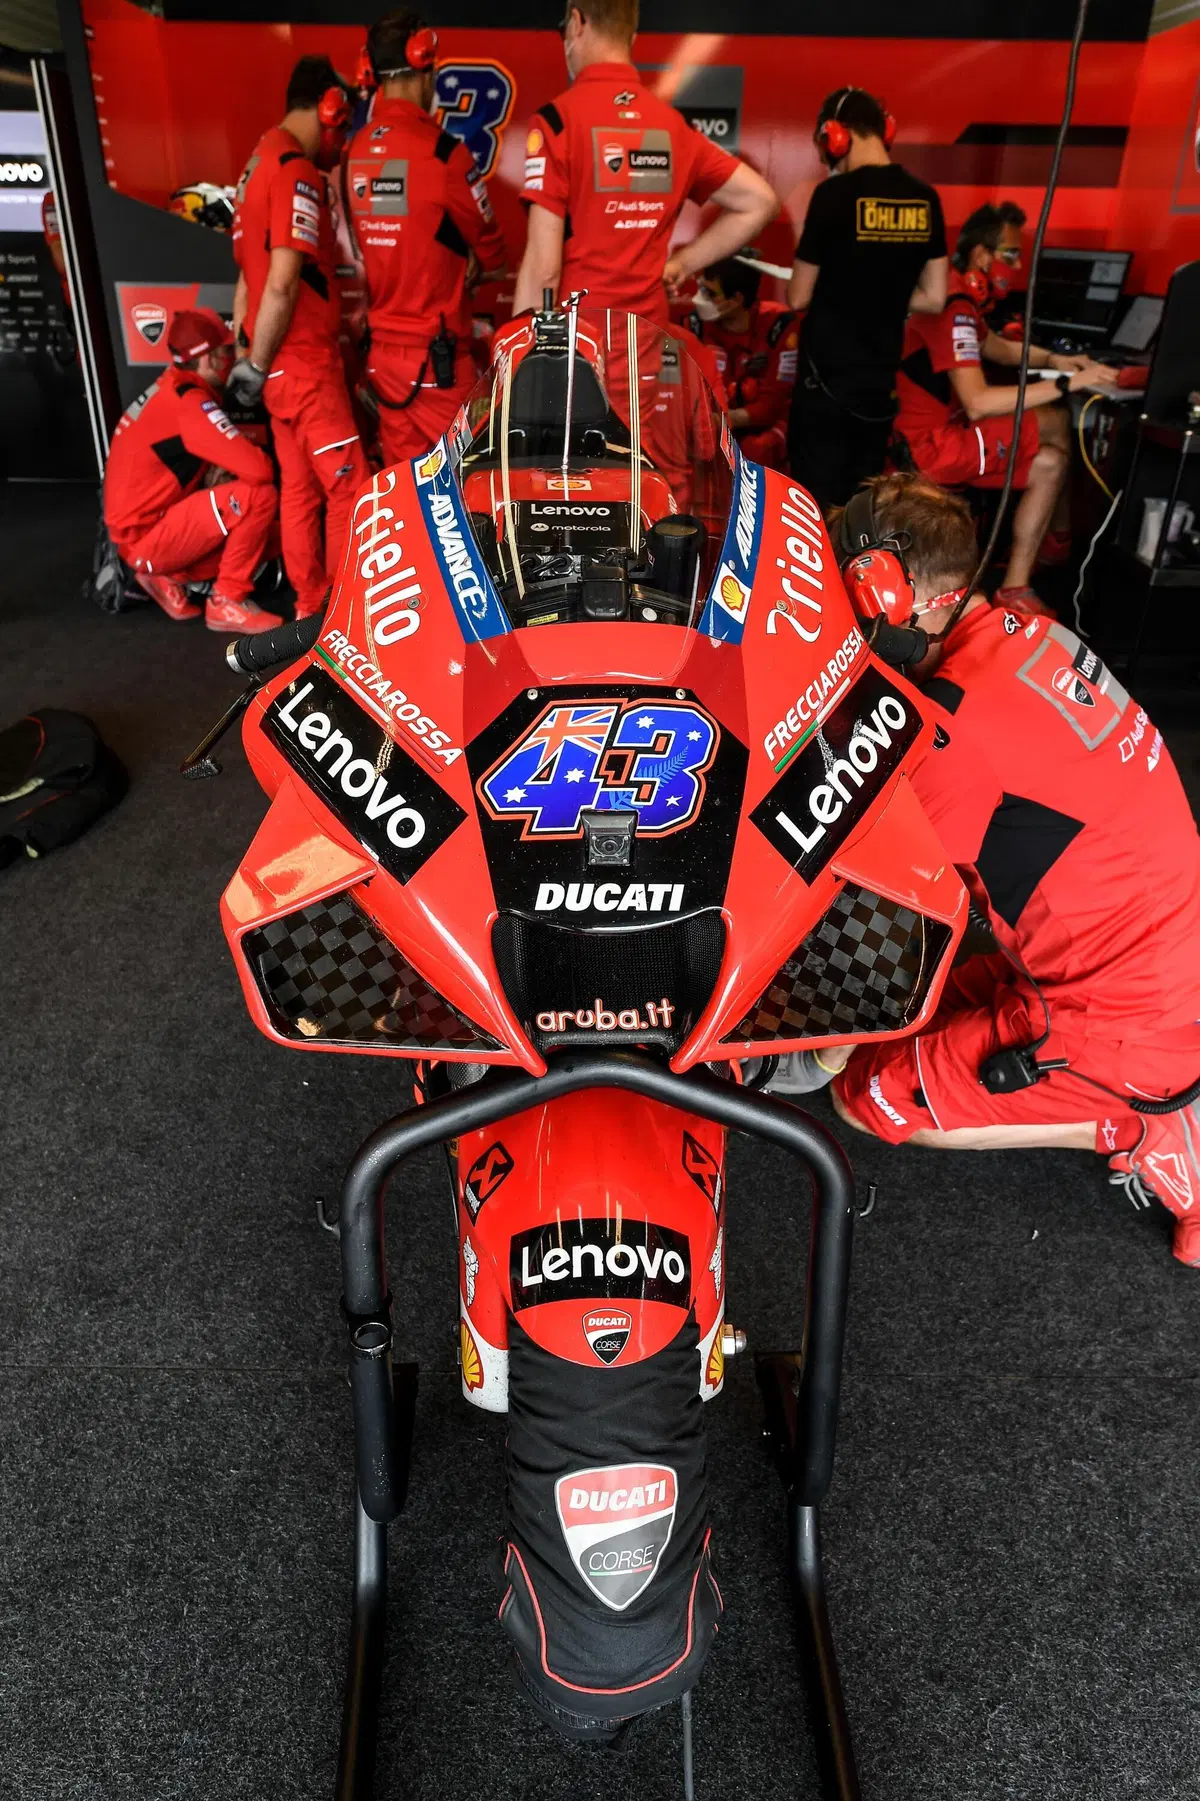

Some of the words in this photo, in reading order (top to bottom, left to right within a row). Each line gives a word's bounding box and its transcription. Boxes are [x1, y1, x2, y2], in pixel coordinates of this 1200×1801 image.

[0, 163, 43, 182] ovo
[630, 154, 668, 166] Lenovo
[372, 181, 402, 192] Lenovo
[638, 201, 665, 212] Sport
[864, 201, 928, 230] ÖHLINS
[531, 503, 611, 517] Lenovo
[551, 524, 612, 532] motorola
[428, 493, 489, 621] ADVANCE
[322, 628, 464, 767] FRECCIAROSSA
[763, 626, 864, 762] FRECCIAROSSA
[277, 682, 427, 849] Lenovo
[476, 697, 721, 840] 43
[775, 695, 907, 854] Lenovo
[534, 883, 685, 912] DUCATI
[535, 999, 675, 1032] aruba.it
[870, 1075, 908, 1126] DUCATI
[521, 1244, 686, 1288] Lenovo
[587, 1317, 627, 1327] DUCATI
[595, 1340, 622, 1350] CORSE
[569, 1479, 667, 1512] DUCATI
[589, 1545, 655, 1571] CORSE
